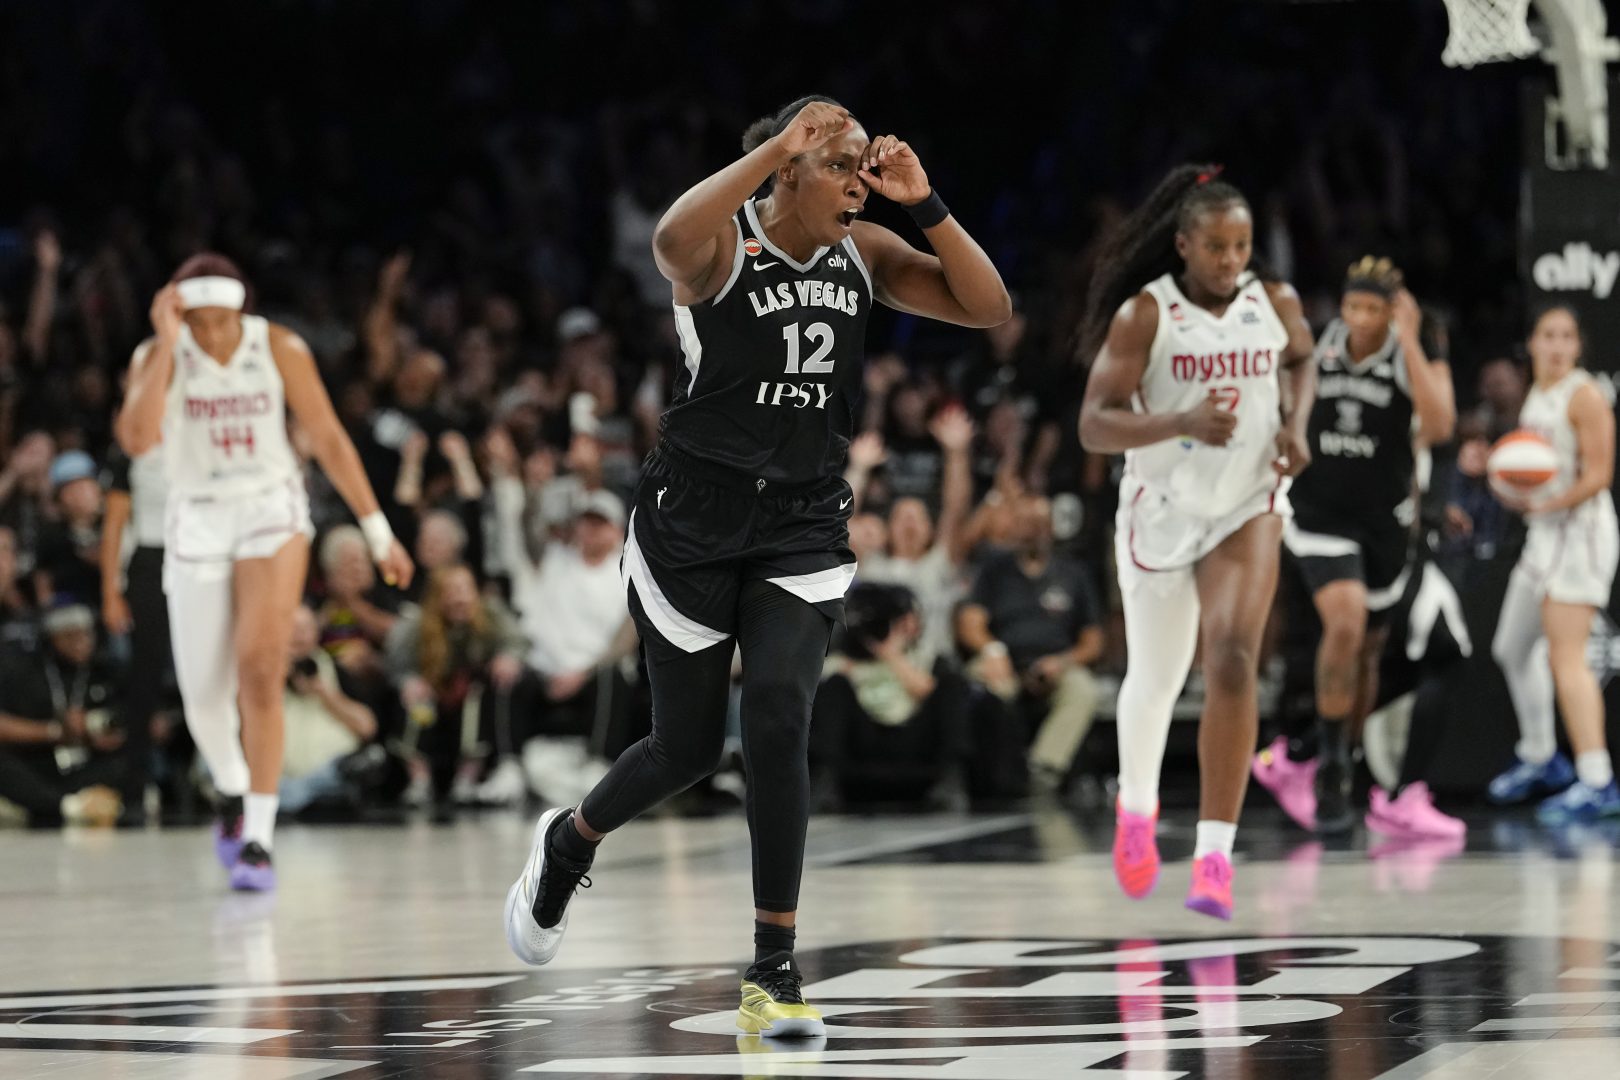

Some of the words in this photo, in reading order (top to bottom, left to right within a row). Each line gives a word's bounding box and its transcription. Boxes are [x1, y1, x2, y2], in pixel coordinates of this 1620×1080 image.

[828, 254, 848, 271] ally
[1533, 241, 1620, 299] ally
[748, 282, 795, 318] LAS
[794, 280, 859, 316] VEGAS
[782, 321, 835, 374] 12
[755, 381, 834, 410] IPSY
[328, 1018, 553, 1049] LAS
[473, 967, 739, 1014] VEGAS
